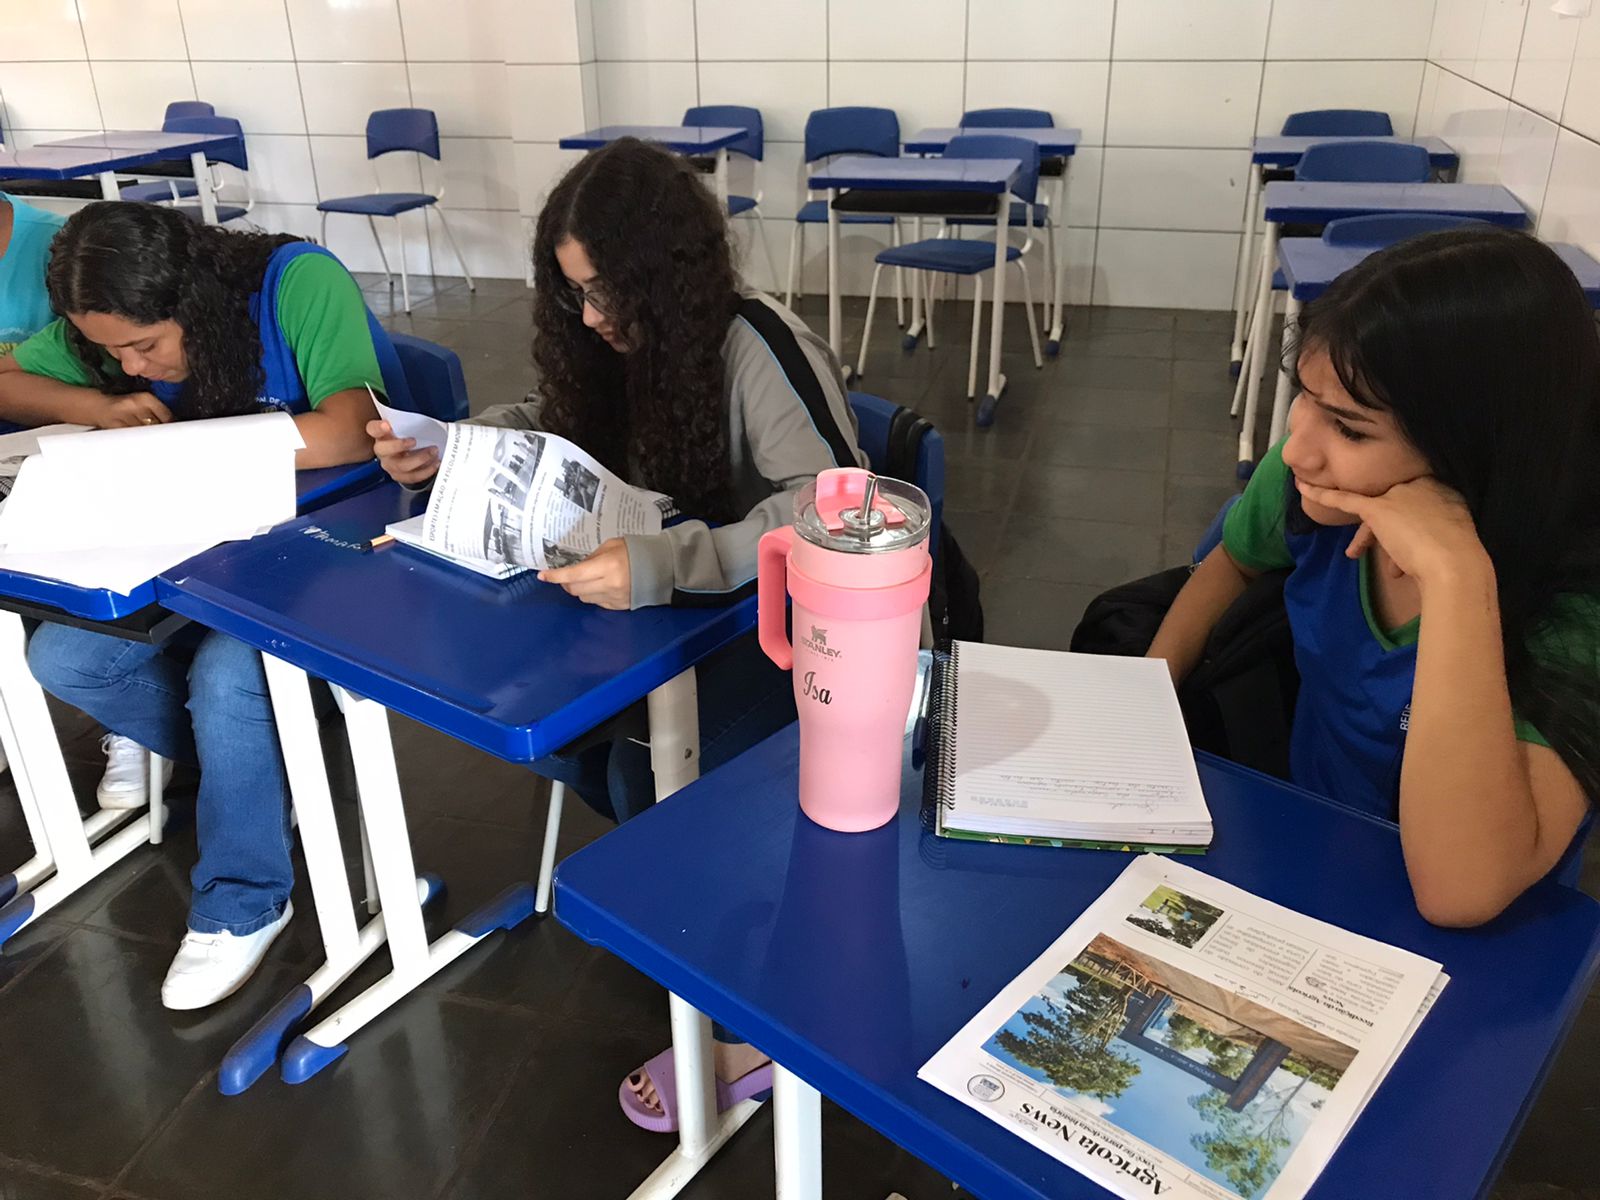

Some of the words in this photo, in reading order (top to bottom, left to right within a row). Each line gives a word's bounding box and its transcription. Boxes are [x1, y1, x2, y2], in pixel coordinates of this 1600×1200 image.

[801, 636, 841, 658] STANLEY
[803, 671, 832, 705] Isa
[1019, 1102, 1076, 1143] News
[1046, 1104, 1079, 1126] história
[1076, 1121, 1101, 1138] desta
[1099, 1133, 1124, 1151] parte
[1078, 1134, 1173, 1195] Agrícola
